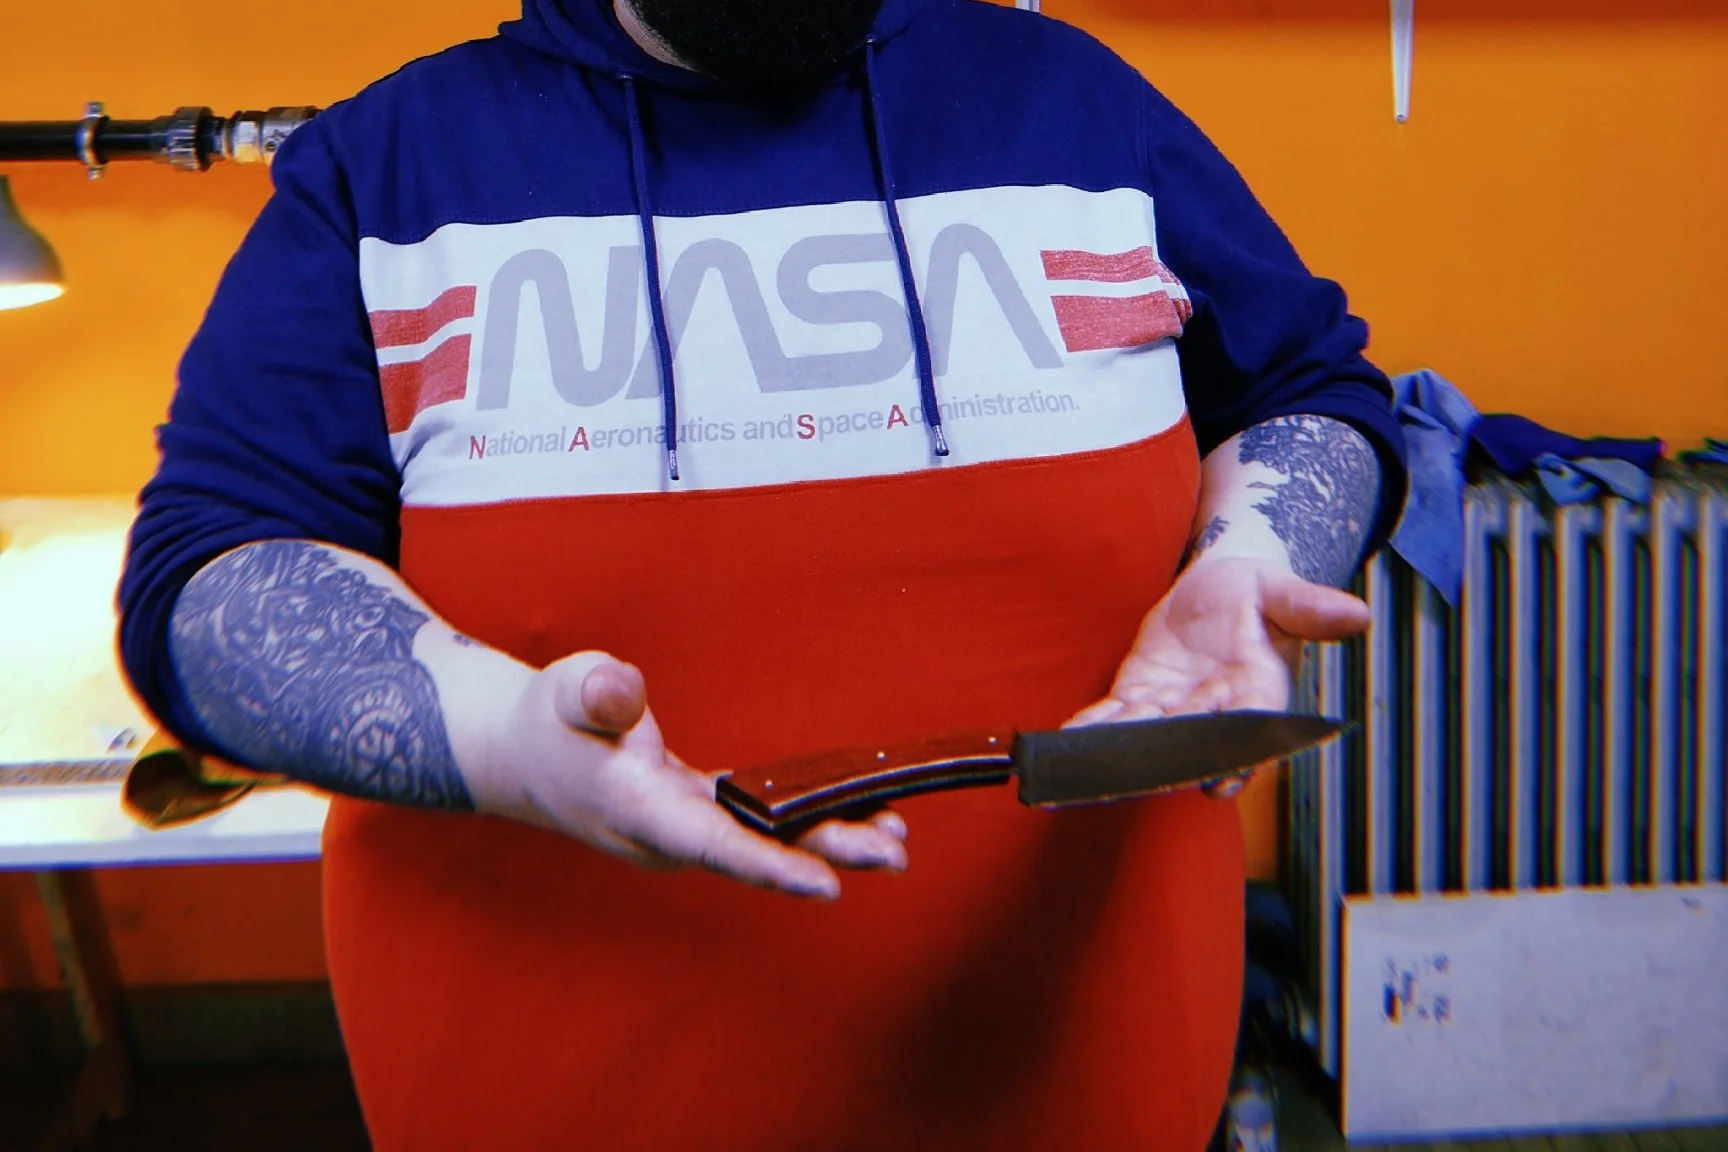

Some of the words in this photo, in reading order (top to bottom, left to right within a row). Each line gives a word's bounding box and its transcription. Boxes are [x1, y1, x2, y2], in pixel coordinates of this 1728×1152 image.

[475, 222, 1067, 412] NASA
[469, 425, 566, 460] National
[568, 416, 736, 452] Aeronautics
[742, 413, 795, 441] and
[796, 409, 884, 443] Space
